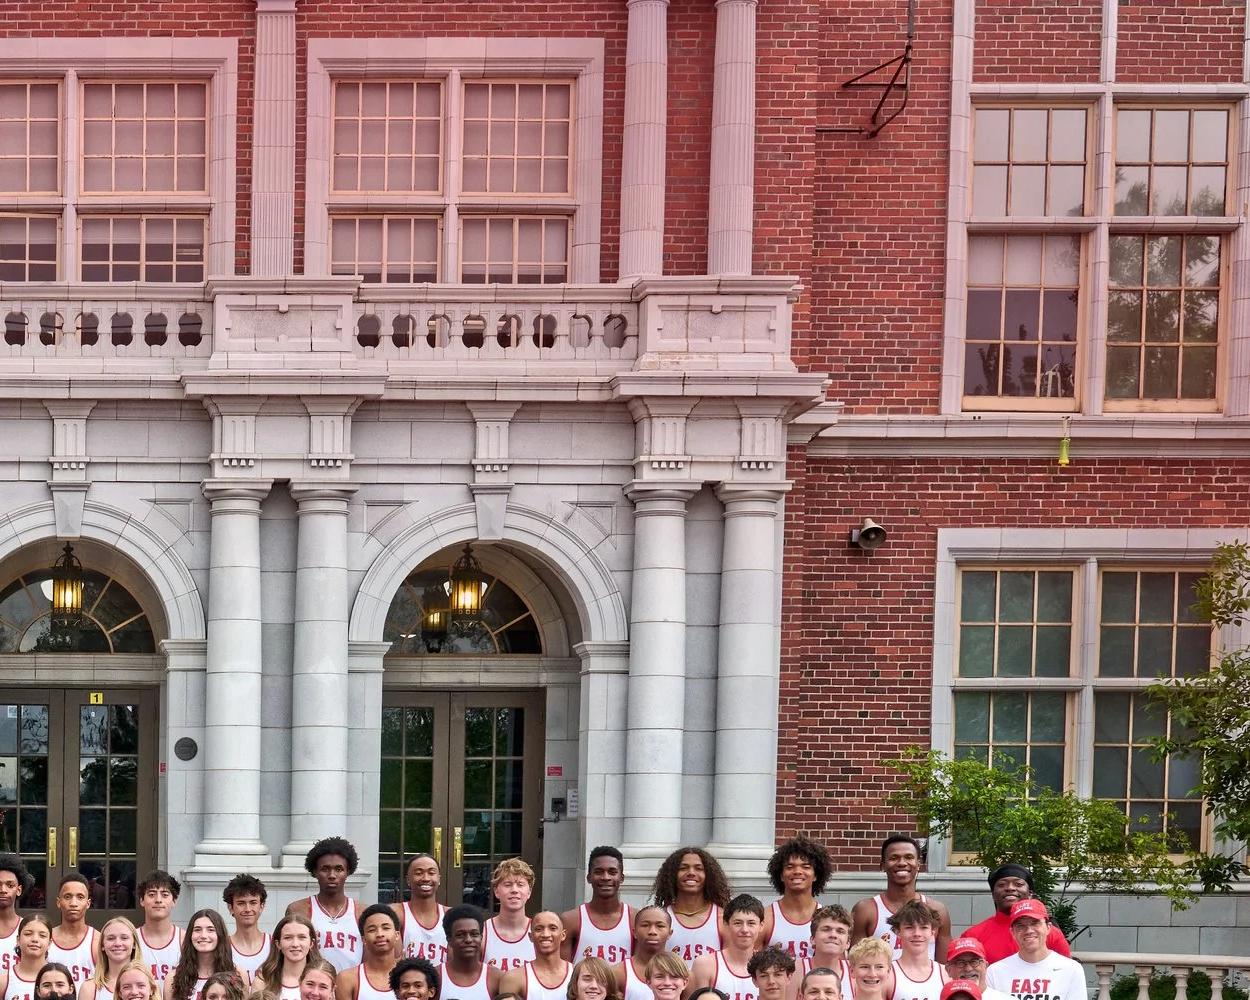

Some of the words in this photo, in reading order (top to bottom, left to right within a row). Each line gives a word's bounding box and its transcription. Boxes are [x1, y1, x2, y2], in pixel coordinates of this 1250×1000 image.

[94, 694, 99, 703] 1
[318, 932, 357, 952] AST
[72, 965, 91, 981] ST
[1011, 979, 1051, 994] EAST
